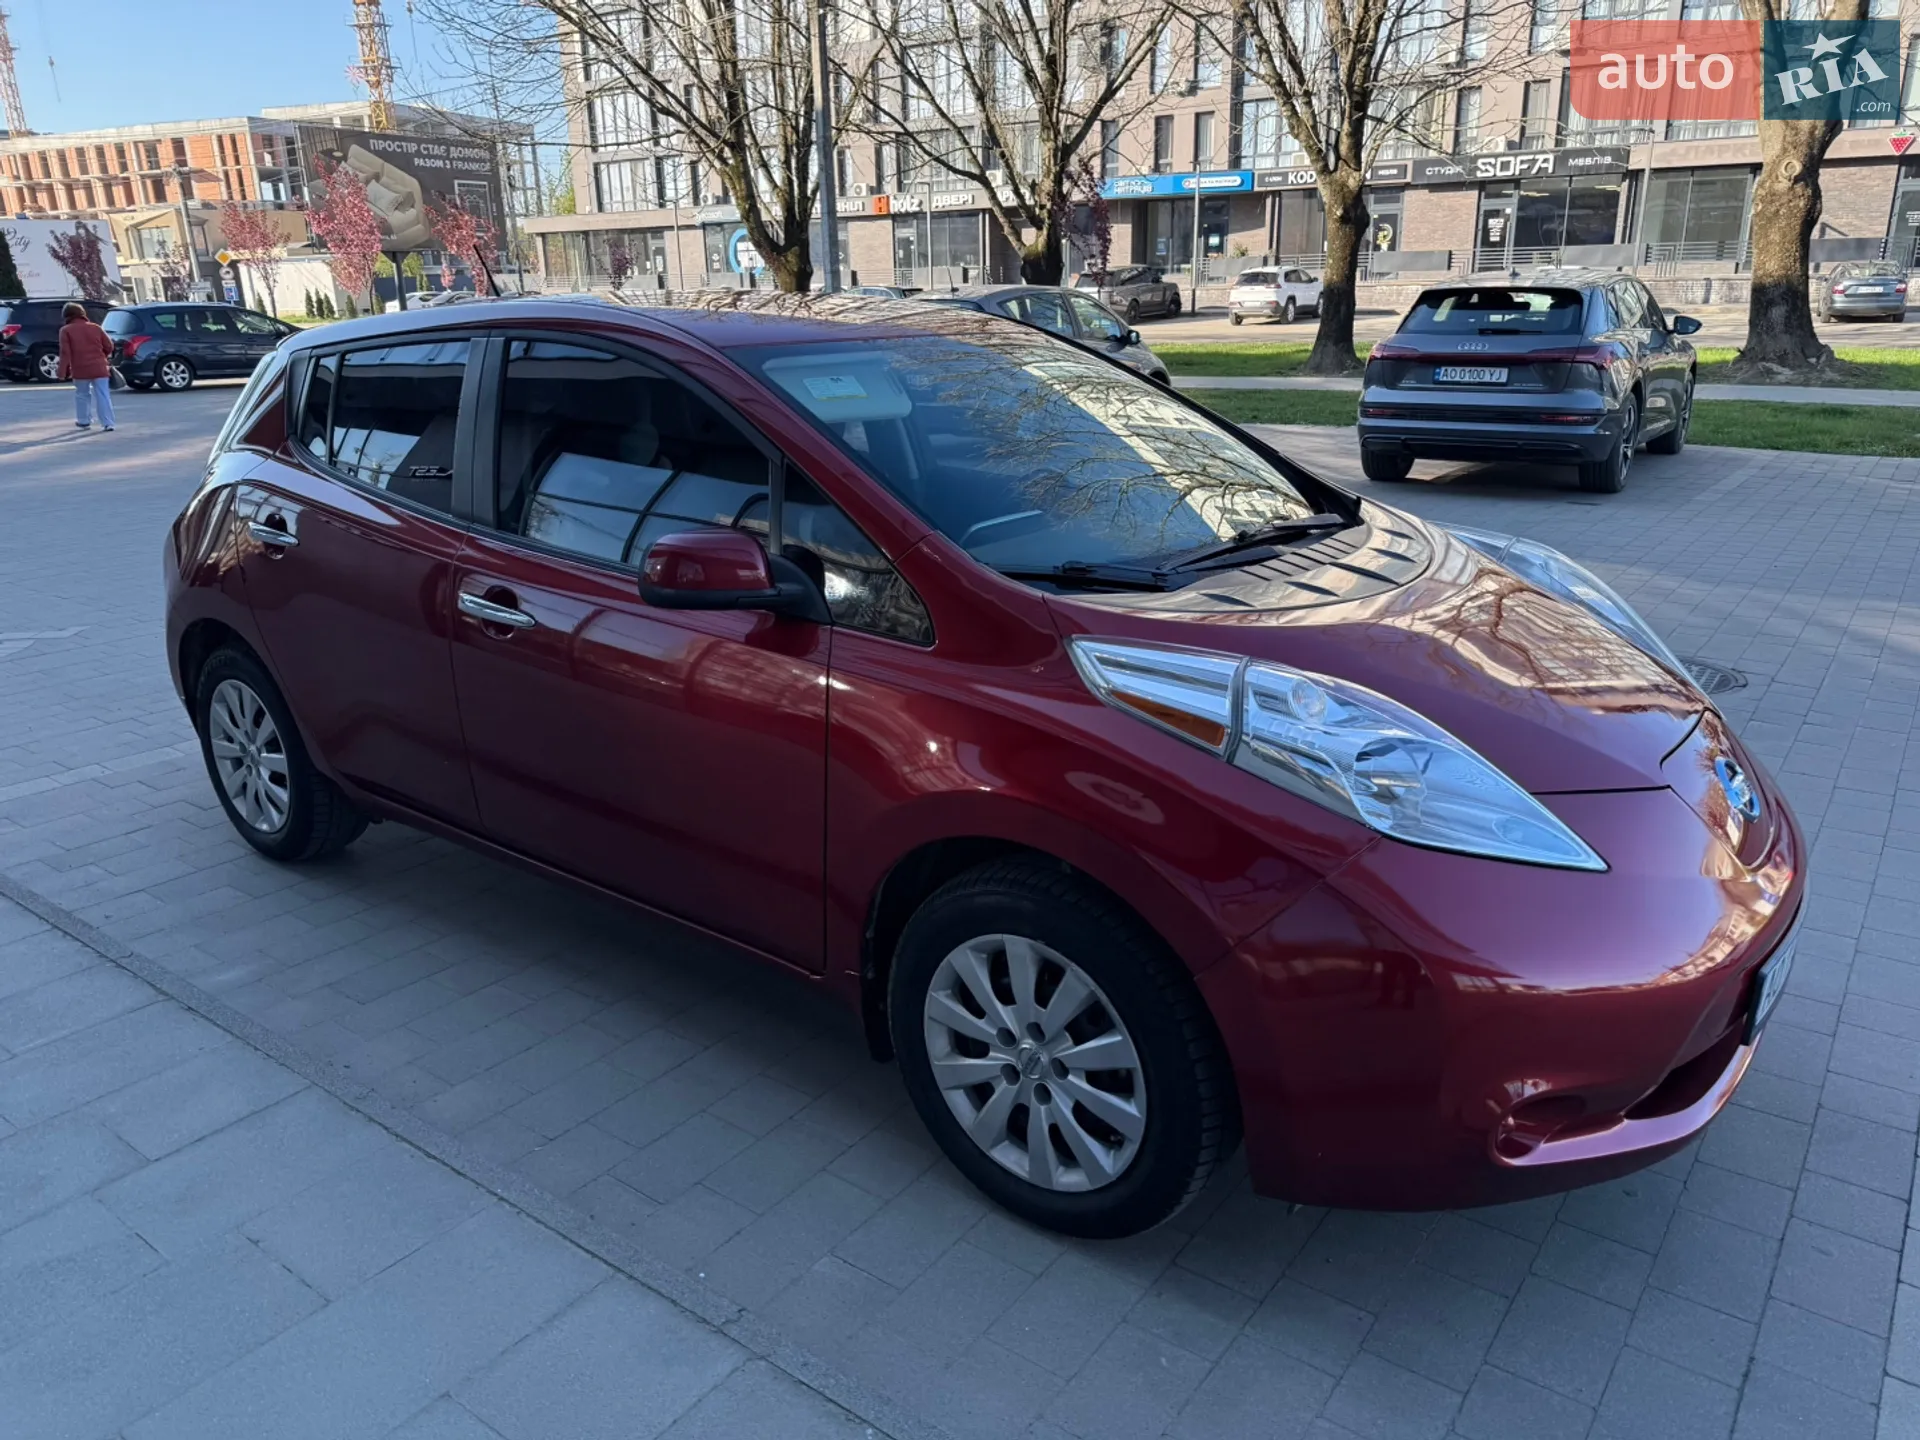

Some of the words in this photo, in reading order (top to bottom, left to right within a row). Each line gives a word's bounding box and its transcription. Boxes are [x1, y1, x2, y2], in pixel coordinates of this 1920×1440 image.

[369, 139, 418, 154] ПРОСТІР
[420, 144, 447, 156] СТАЄ
[414, 158, 443, 169] РАЗОМ
[1476, 154, 1554, 178] SOFA
[932, 193, 974, 209] ДВЕРІ
[1442, 368, 1457, 380] AO
[1459, 368, 1485, 380] 0100
